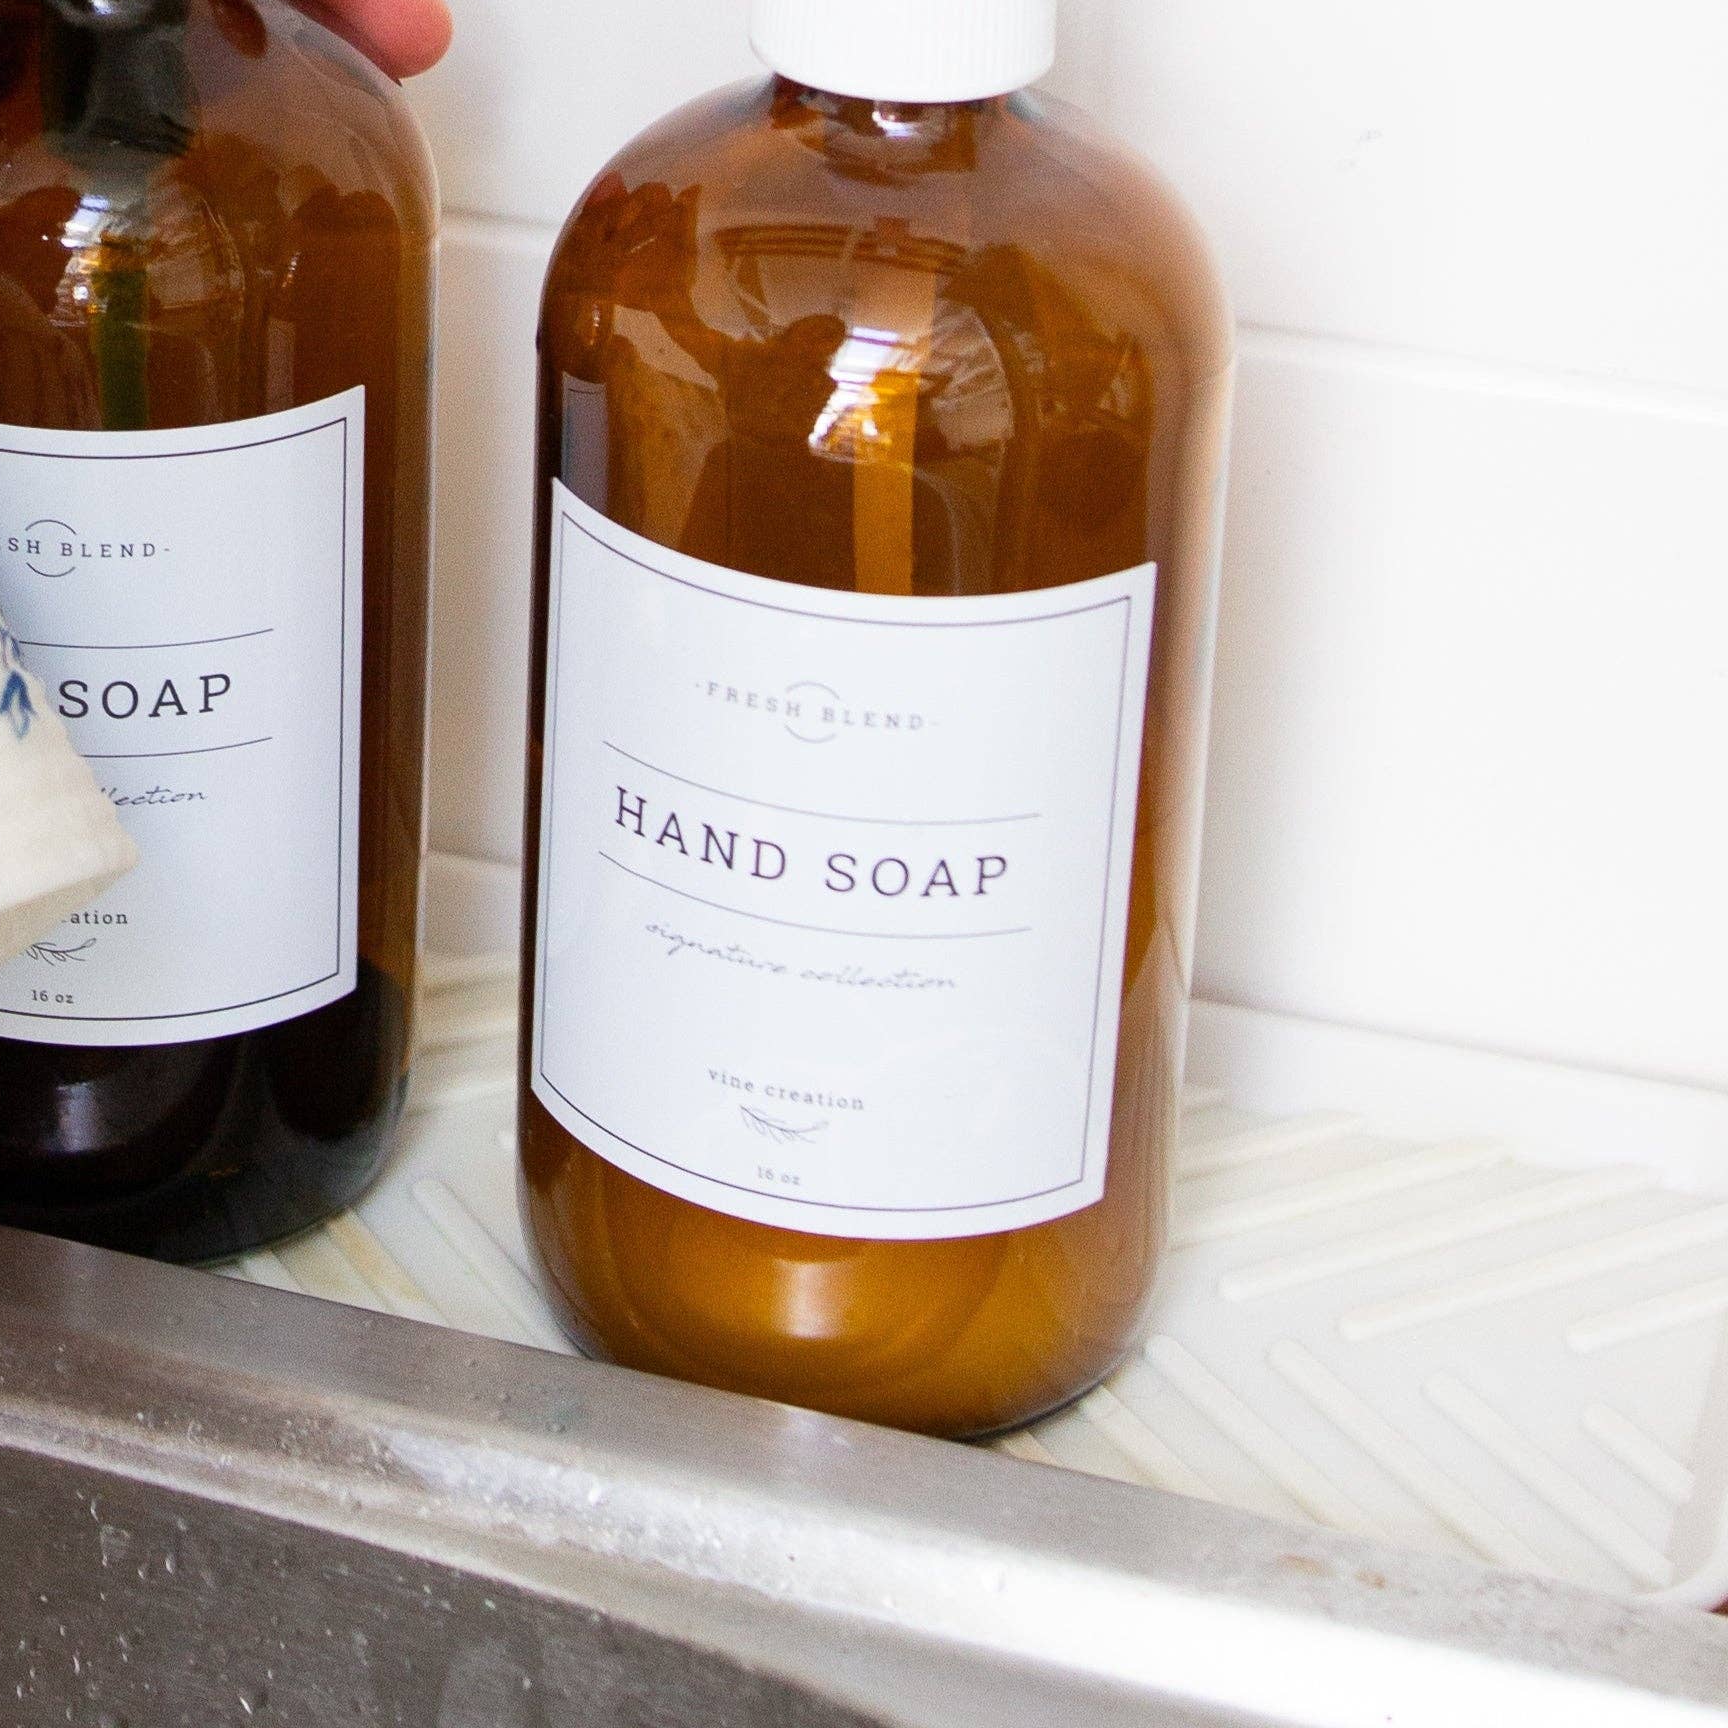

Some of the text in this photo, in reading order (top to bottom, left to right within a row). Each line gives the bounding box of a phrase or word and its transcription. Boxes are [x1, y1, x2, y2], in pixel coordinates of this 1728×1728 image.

[58, 673, 231, 719] SOAP
[614, 785, 1008, 898] HAND SOAP
[62, 910, 129, 925] ation
[644, 921, 956, 989] signature collection
[31, 989, 75, 1004] 16 oz
[708, 1068, 865, 1111] vine creation
[756, 1165, 801, 1186] 16 oz
